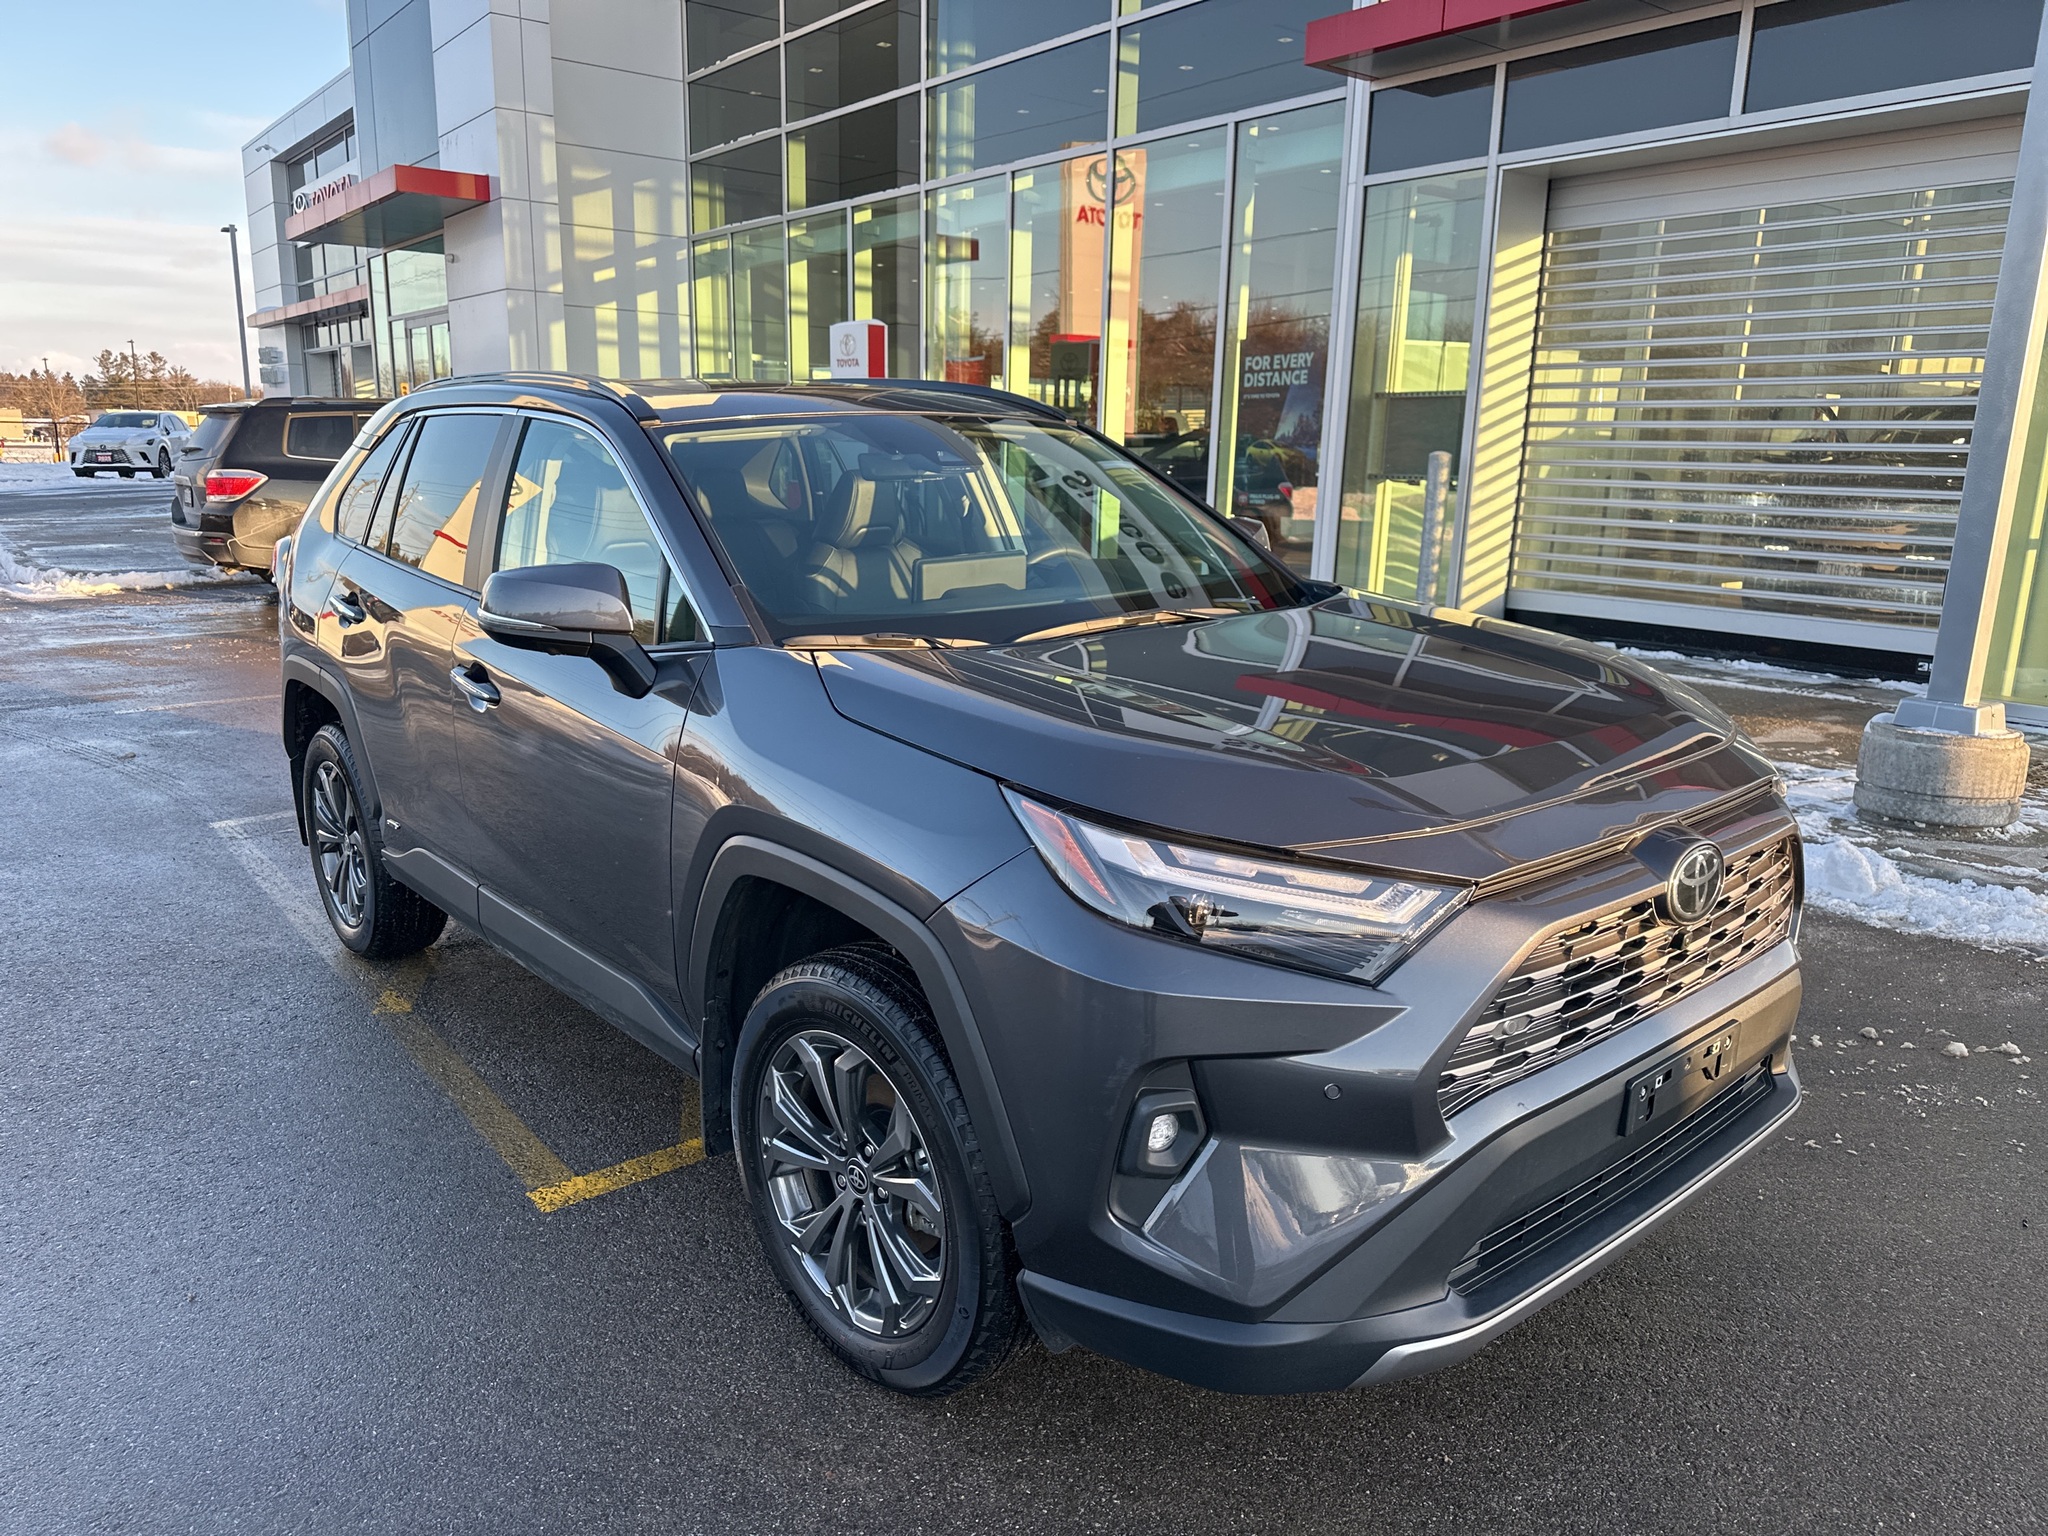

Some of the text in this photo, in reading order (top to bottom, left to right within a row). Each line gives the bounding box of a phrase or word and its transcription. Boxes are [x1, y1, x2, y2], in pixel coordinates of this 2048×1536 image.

[836, 358, 860, 368] TOYOTA
[1245, 351, 1314, 371] FOR EVERY
[1244, 369, 1308, 388] DISTANCE
[824, 1000, 896, 1060] MICHELIN
